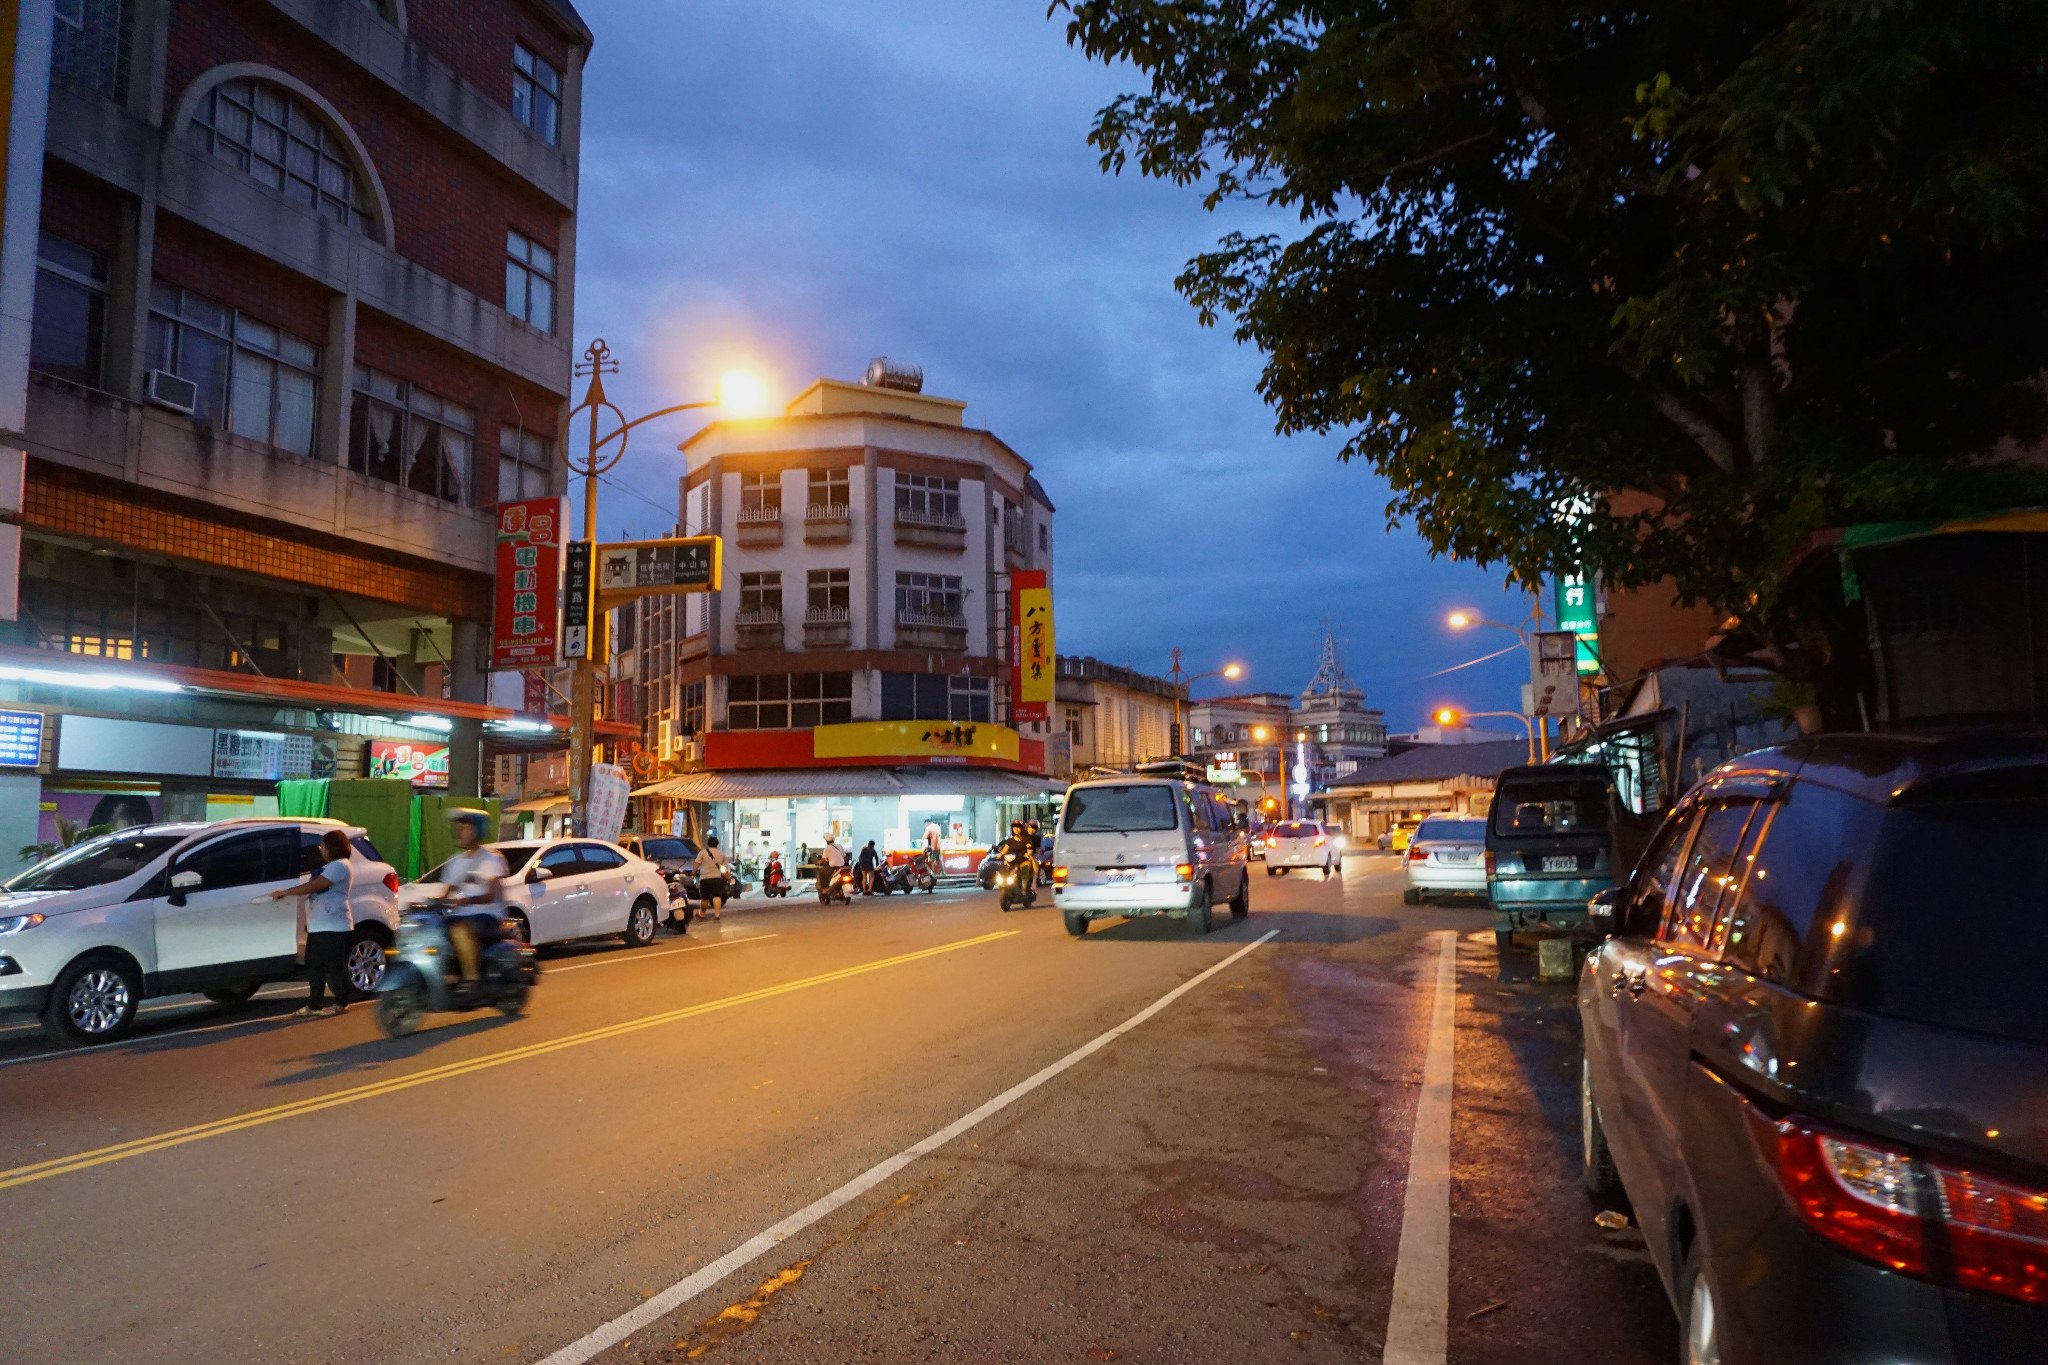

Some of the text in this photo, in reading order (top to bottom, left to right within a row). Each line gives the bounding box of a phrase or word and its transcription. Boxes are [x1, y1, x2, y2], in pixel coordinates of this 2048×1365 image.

[572, 560, 584, 604] 中正路
[678, 559, 708, 570] 中山路
[513, 546, 538, 635] 電動機車
